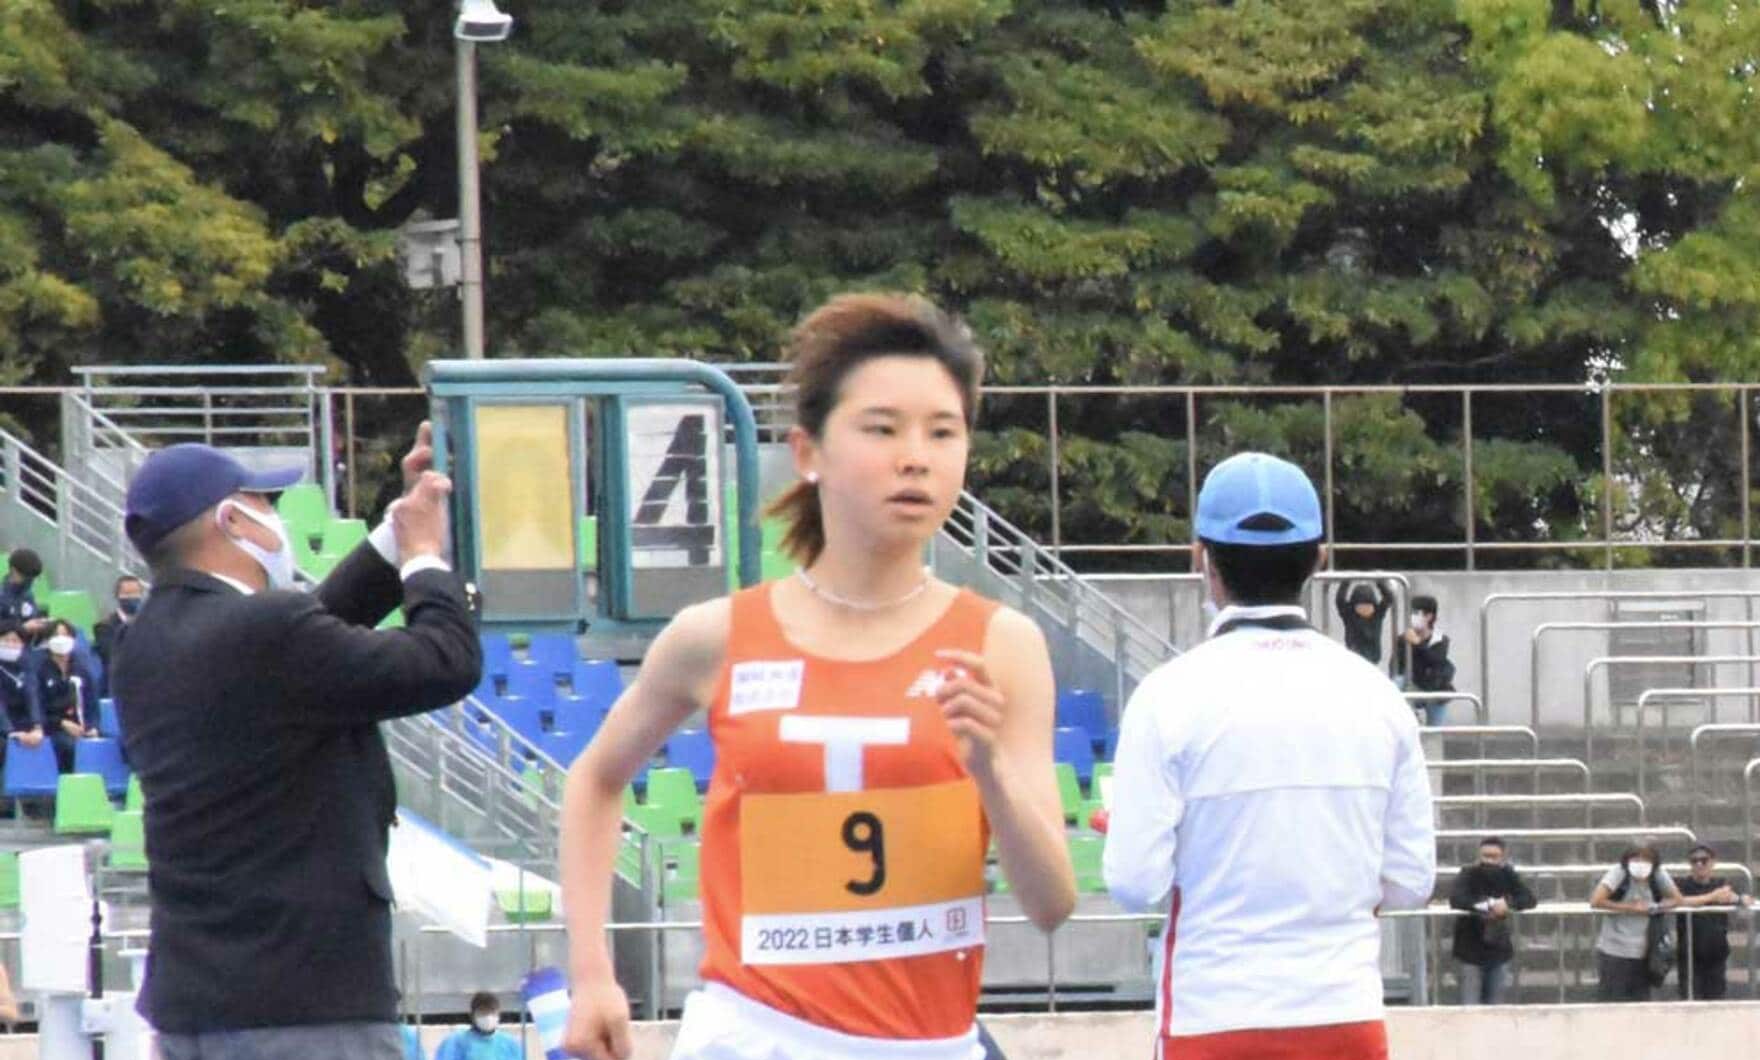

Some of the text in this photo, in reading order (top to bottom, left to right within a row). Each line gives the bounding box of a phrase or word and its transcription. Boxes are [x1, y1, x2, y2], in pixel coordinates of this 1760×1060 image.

[631, 414, 715, 566] 4
[779, 714, 911, 792] T
[841, 811, 886, 896] 9
